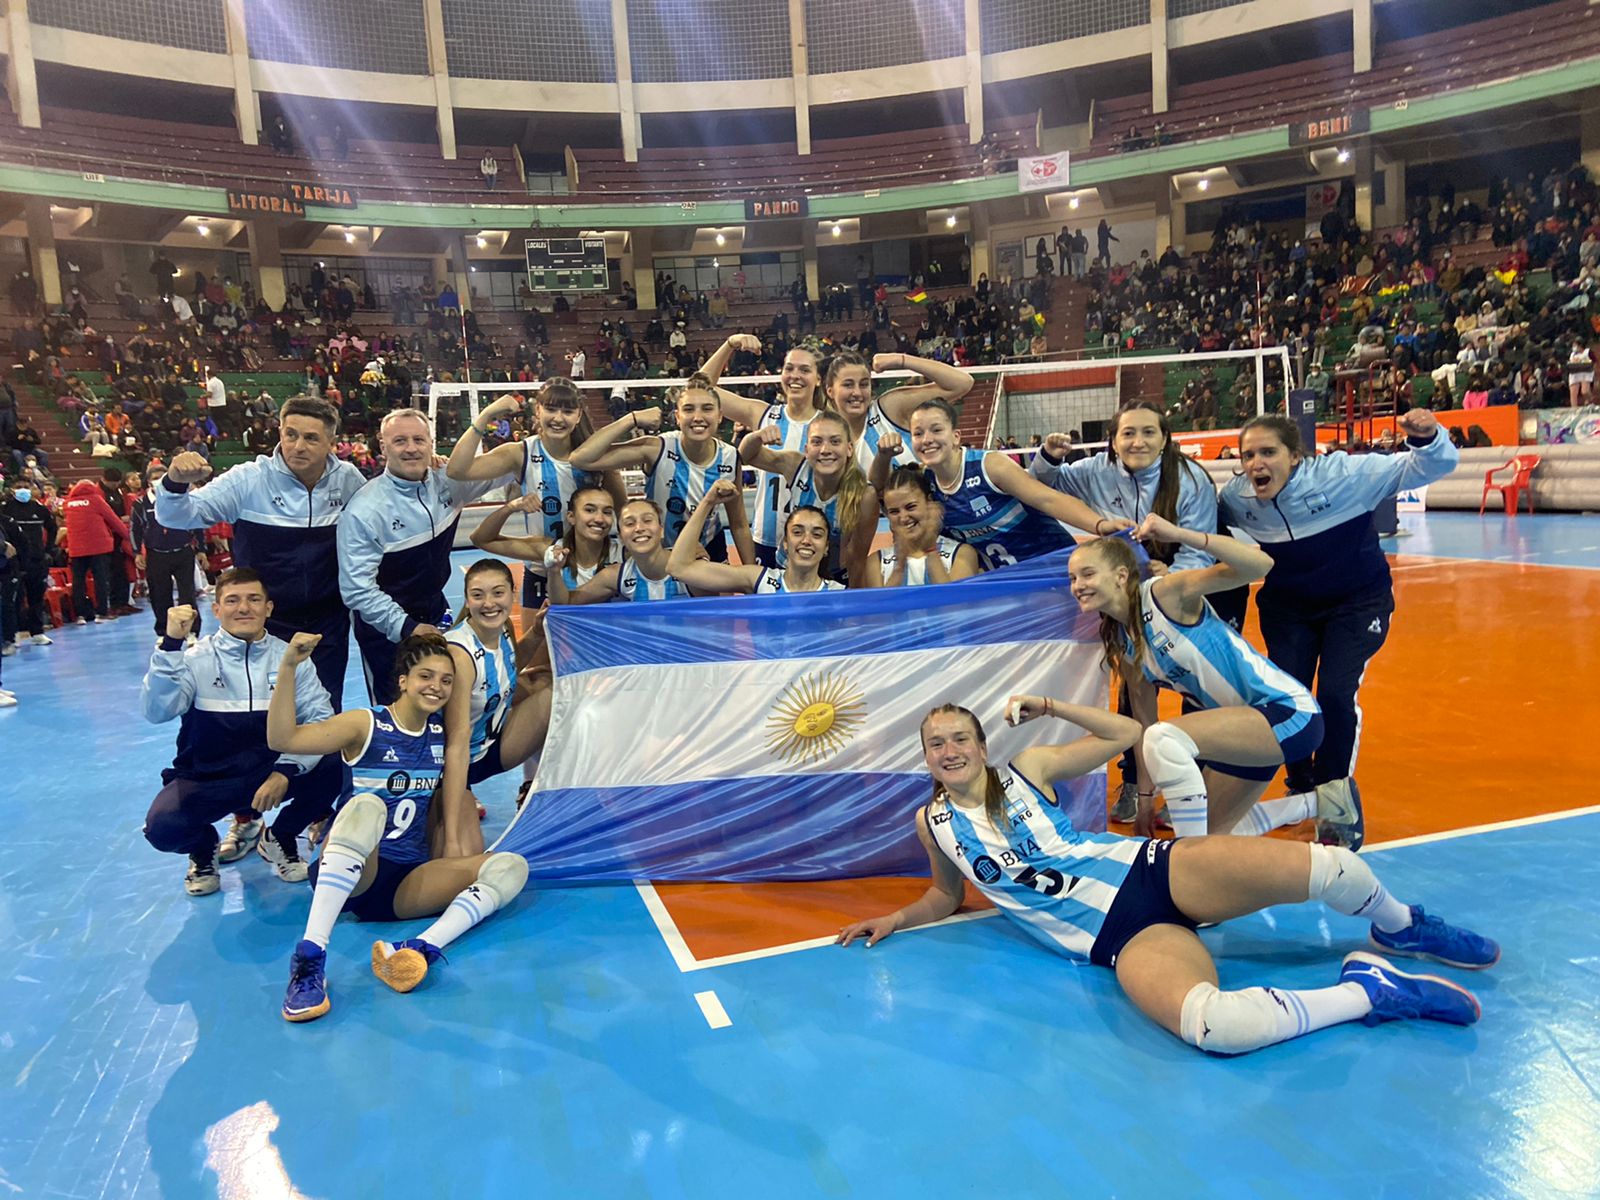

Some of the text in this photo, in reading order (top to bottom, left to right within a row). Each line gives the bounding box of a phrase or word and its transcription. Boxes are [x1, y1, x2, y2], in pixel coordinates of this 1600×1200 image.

[1308, 115, 1349, 139] BENI
[229, 193, 304, 214] LITORAL
[291, 185, 353, 204] TARIJA
[753, 200, 799, 216] PANDO
[386, 798, 416, 839] 9
[1012, 809, 1033, 828] ARG
[999, 838, 1041, 867] BNA
